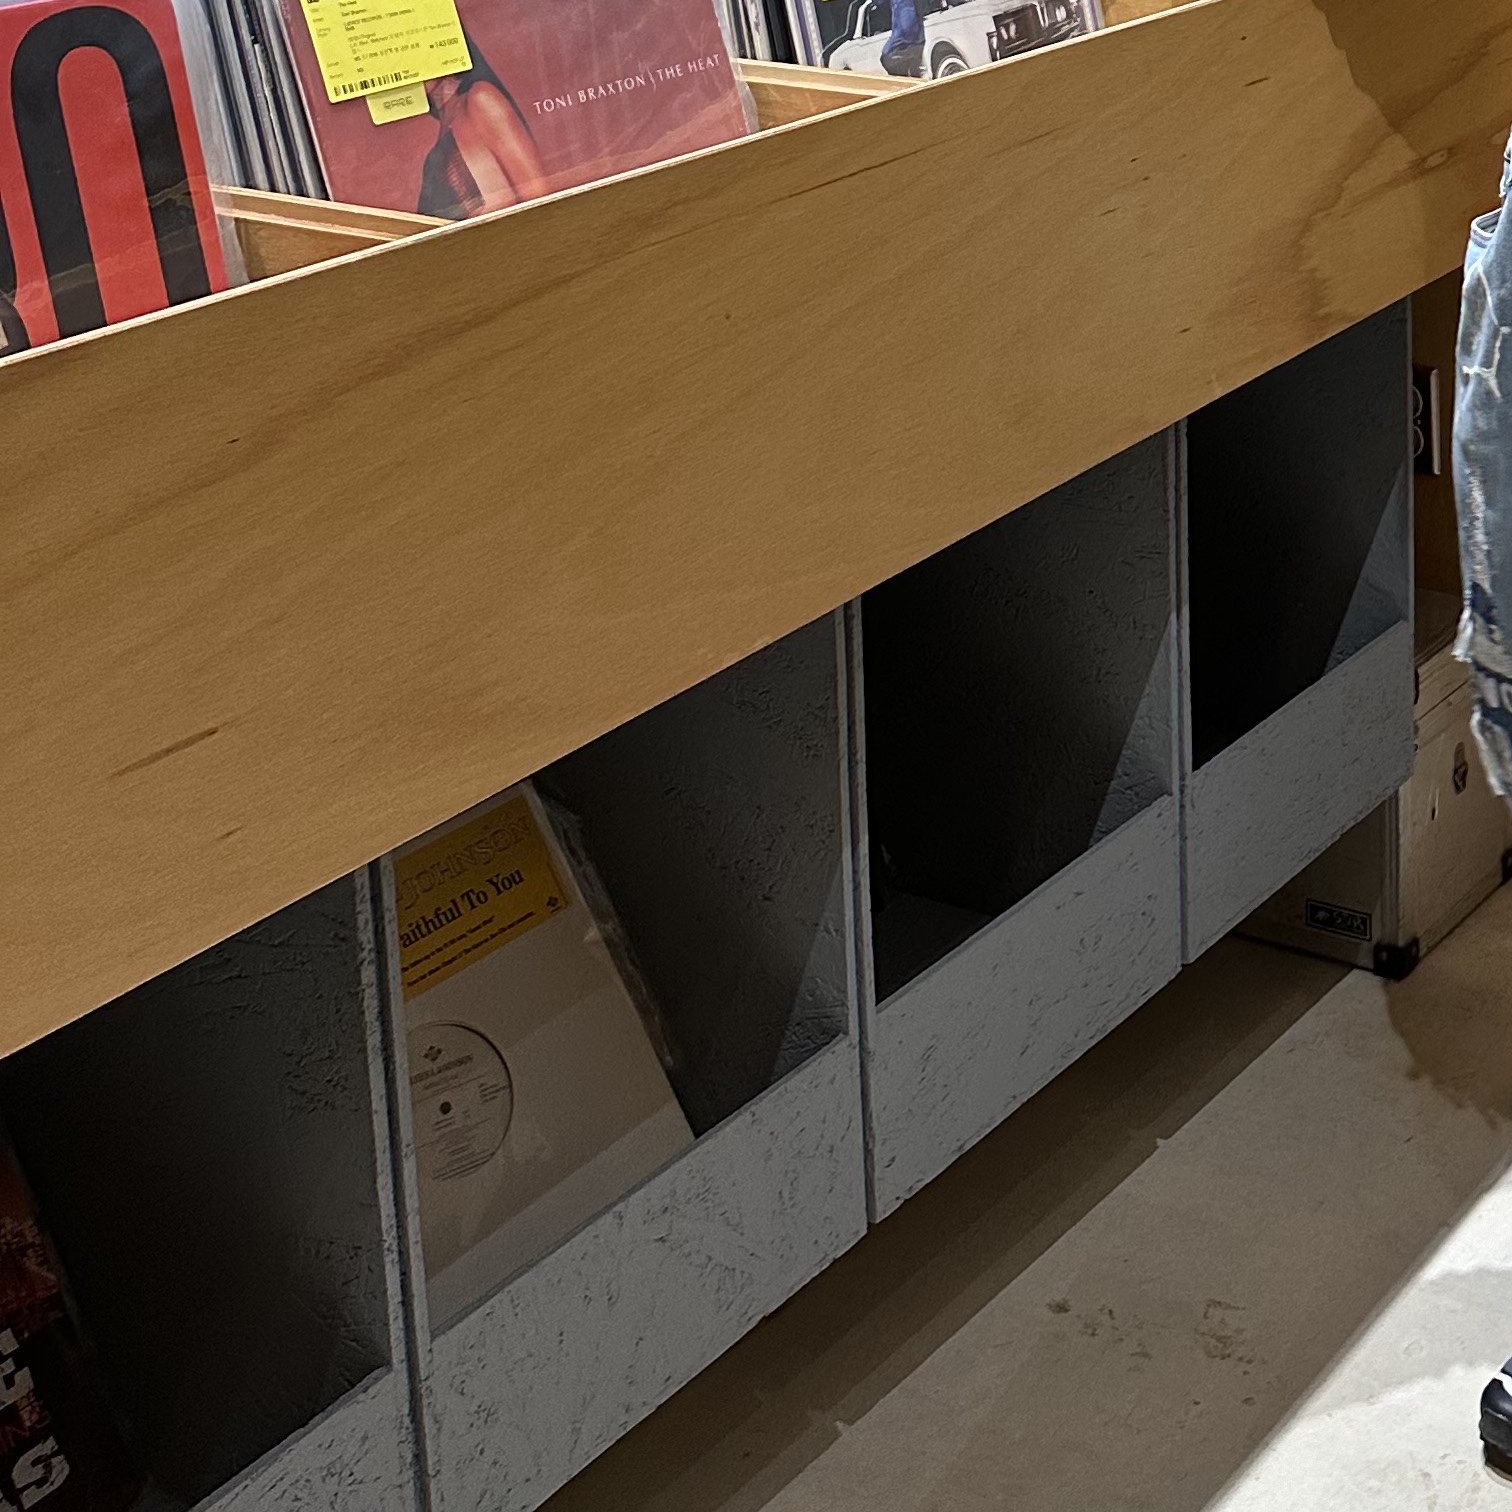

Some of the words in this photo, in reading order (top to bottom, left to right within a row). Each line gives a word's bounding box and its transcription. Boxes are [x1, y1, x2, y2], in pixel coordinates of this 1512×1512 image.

[533, 96, 573, 115] TONI
[577, 75, 646, 103] BRAXTON
[656, 64, 684, 82] THE
[687, 53, 720, 73] HEAT
[399, 814, 531, 911] JOHNSON
[399, 897, 464, 949] aithful
[460, 888, 490, 911] To
[486, 868, 526, 897] You
